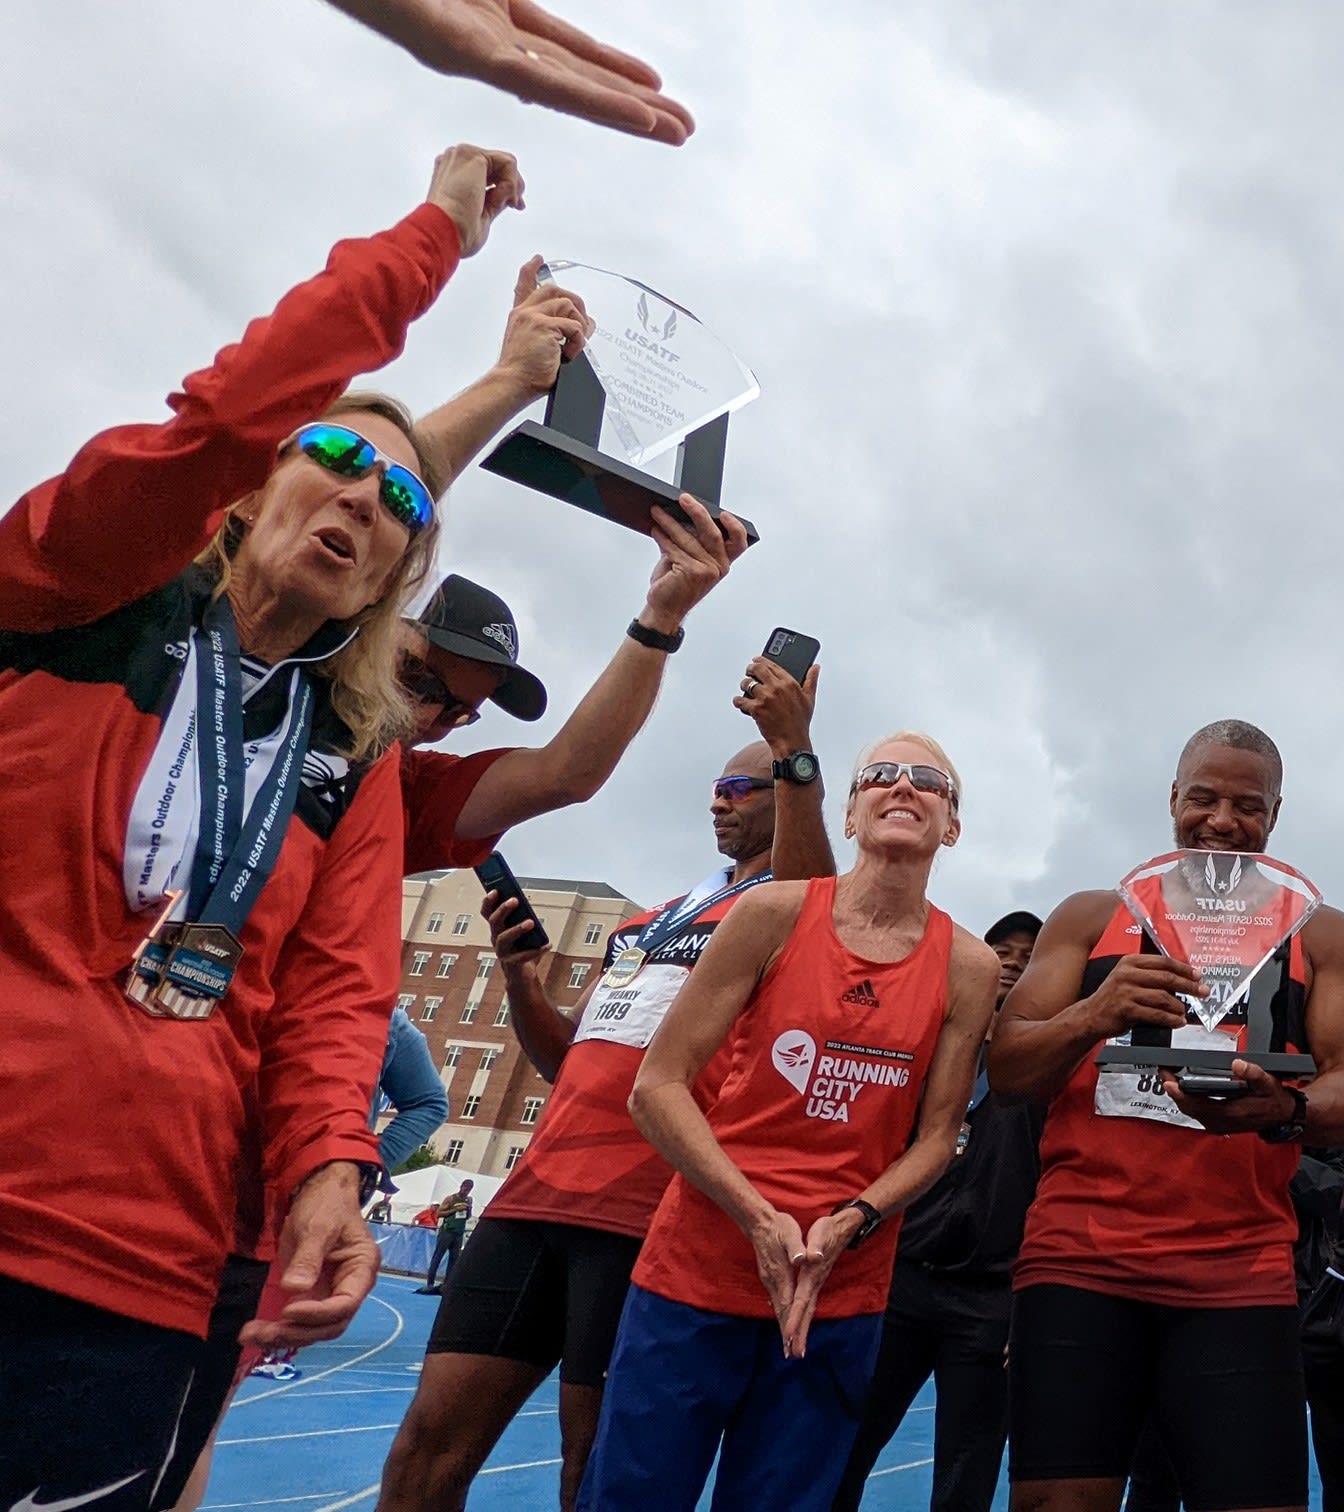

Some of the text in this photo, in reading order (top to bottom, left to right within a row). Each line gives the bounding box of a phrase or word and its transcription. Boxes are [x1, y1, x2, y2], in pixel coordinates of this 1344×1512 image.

[624, 328, 680, 362] USATF
[660, 401, 685, 421] TEAM
[213, 653, 226, 691] USATF
[214, 688, 226, 734] Masters
[215, 735, 228, 783] Outdoor
[139, 833, 161, 885] Masters
[151, 781, 176, 829] Outdoor
[209, 785, 228, 884] Championships
[229, 869, 252, 903] 2022
[248, 830, 269, 869] USATF
[262, 788, 283, 833] Masters
[278, 750, 294, 789] Outdoor
[170, 961, 227, 991] CHAMPIONSHIPS
[593, 1001, 633, 1021] 1189
[841, 993, 880, 1009] adidas
[826, 1041, 841, 1049] 2022
[841, 1044, 866, 1053] ATLANTA
[865, 1048, 884, 1056] TRACK
[883, 1050, 897, 1058] CLUB
[817, 1055, 910, 1088] RUNNING
[812, 1077, 864, 1102] CITY
[805, 1098, 849, 1123] USA
